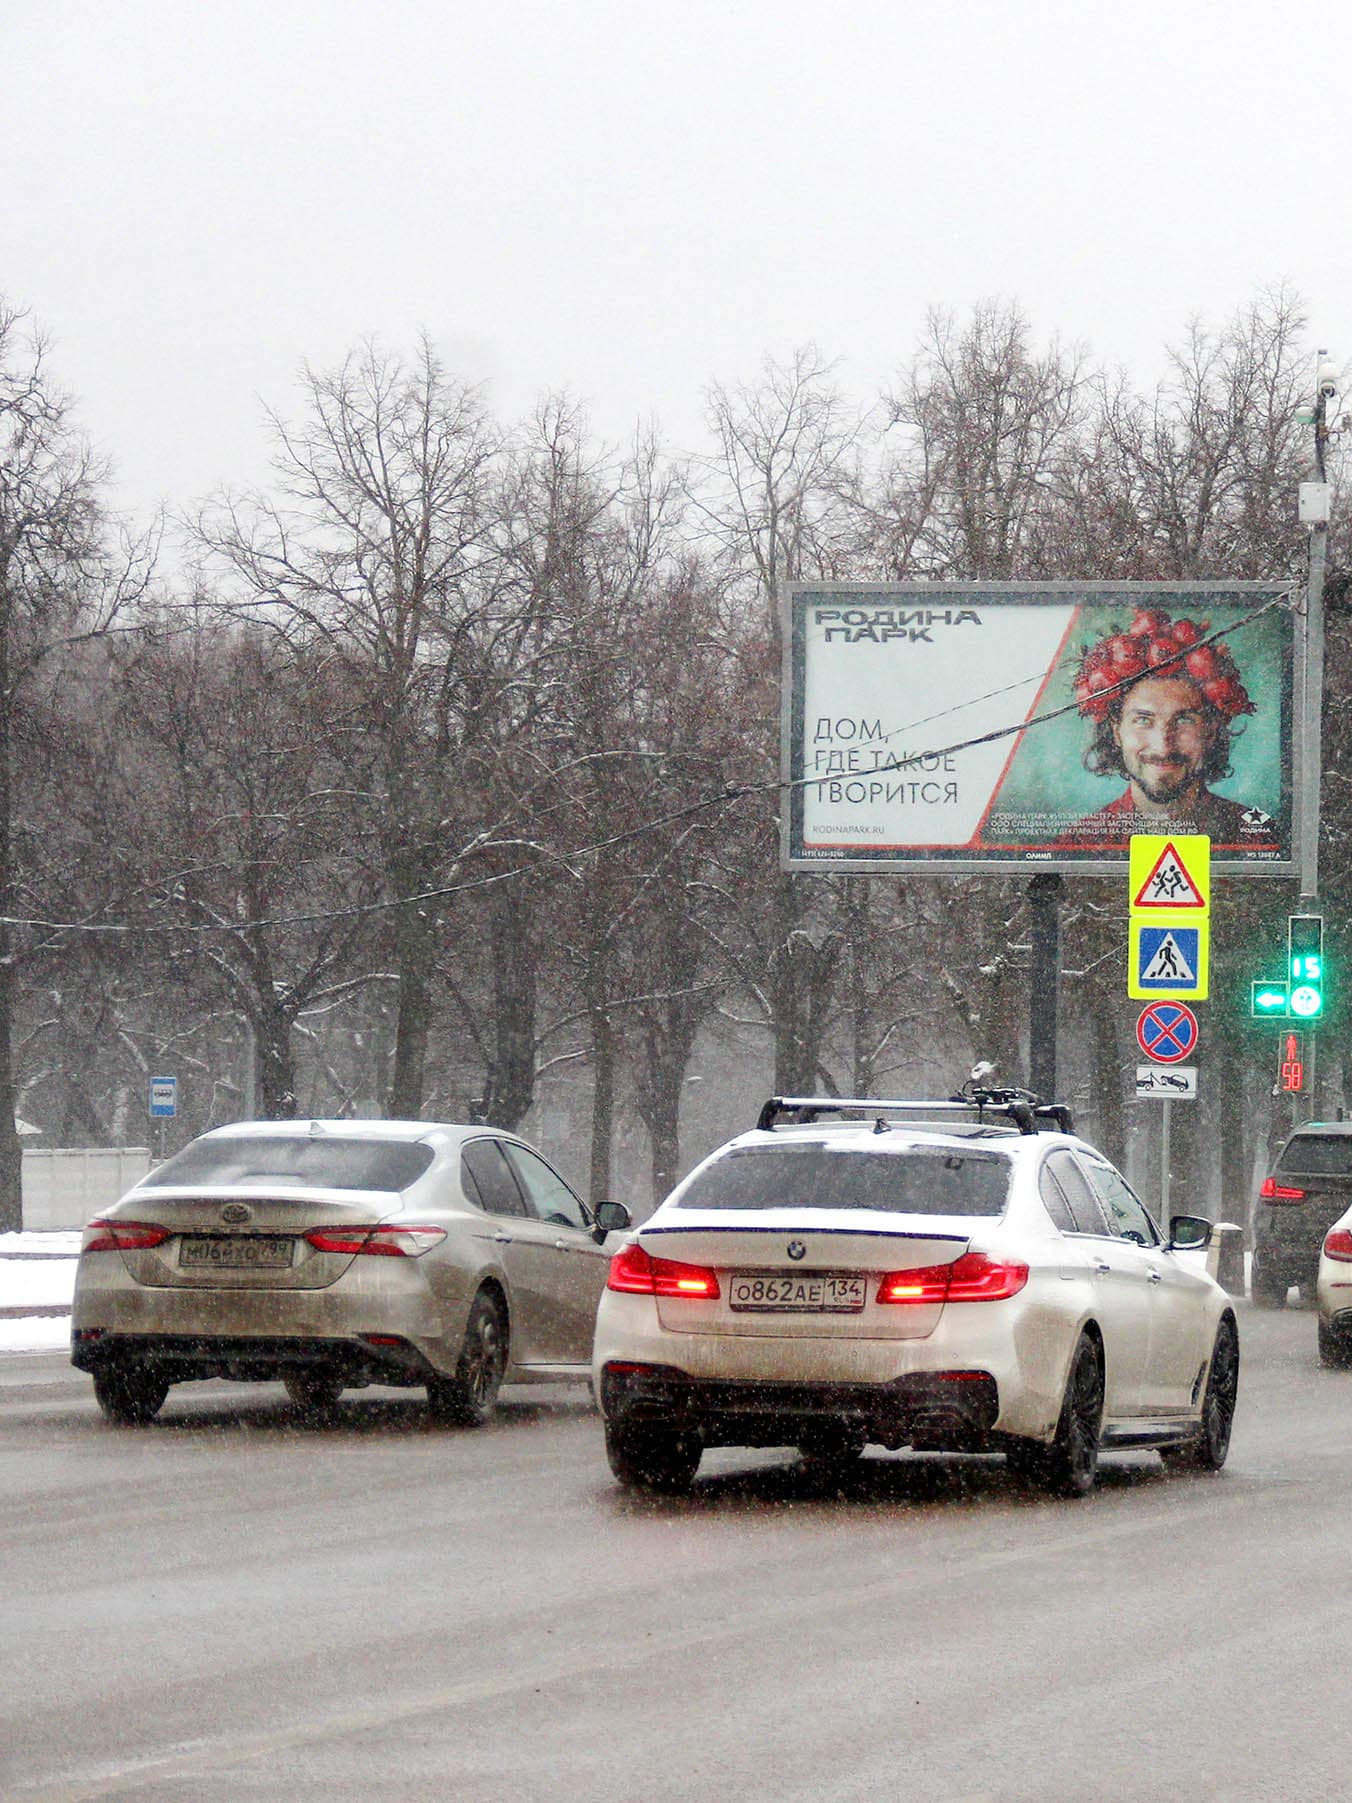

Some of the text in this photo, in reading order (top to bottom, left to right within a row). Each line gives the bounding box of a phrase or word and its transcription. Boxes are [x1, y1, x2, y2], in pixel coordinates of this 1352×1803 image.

[815, 610, 982, 630] РОДИНА
[825, 627, 934, 643] ПАРК
[813, 718, 889, 744] ДОМ,
[815, 750, 956, 775] ГДЕ ТАКОЕ
[815, 781, 958, 804] ТВОРИТСЯ
[812, 825, 885, 834] RODINAPARK.RU
[1025, 852, 1052, 860] ОЛИМП
[1293, 957, 1321, 979] 15
[827, 1280, 862, 1296] 134
